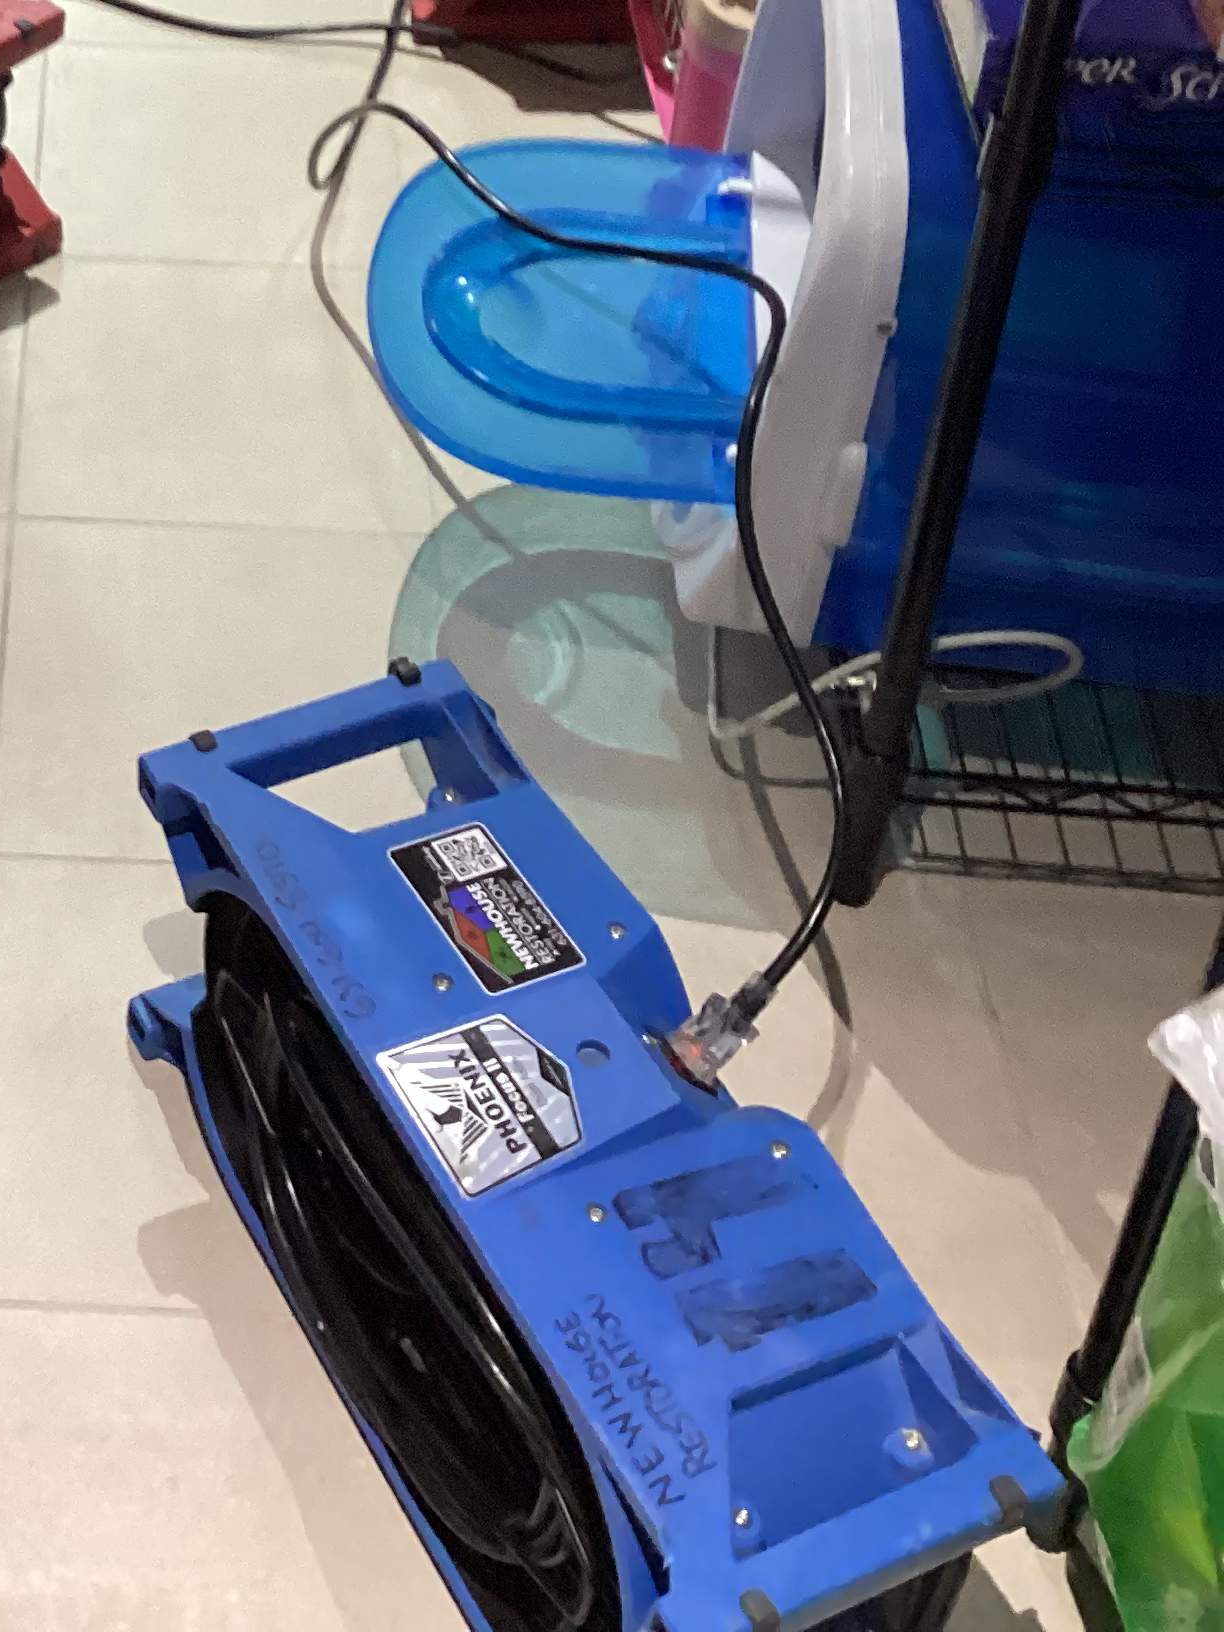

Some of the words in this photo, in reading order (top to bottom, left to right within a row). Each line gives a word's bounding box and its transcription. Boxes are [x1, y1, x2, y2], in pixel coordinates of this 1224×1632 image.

[466, 880, 539, 970] NEWHOUSE
[482, 876, 556, 966] RESTORATION
[447, 1048, 529, 1155] PHOENIX
[497, 1071, 536, 1124] Focus
